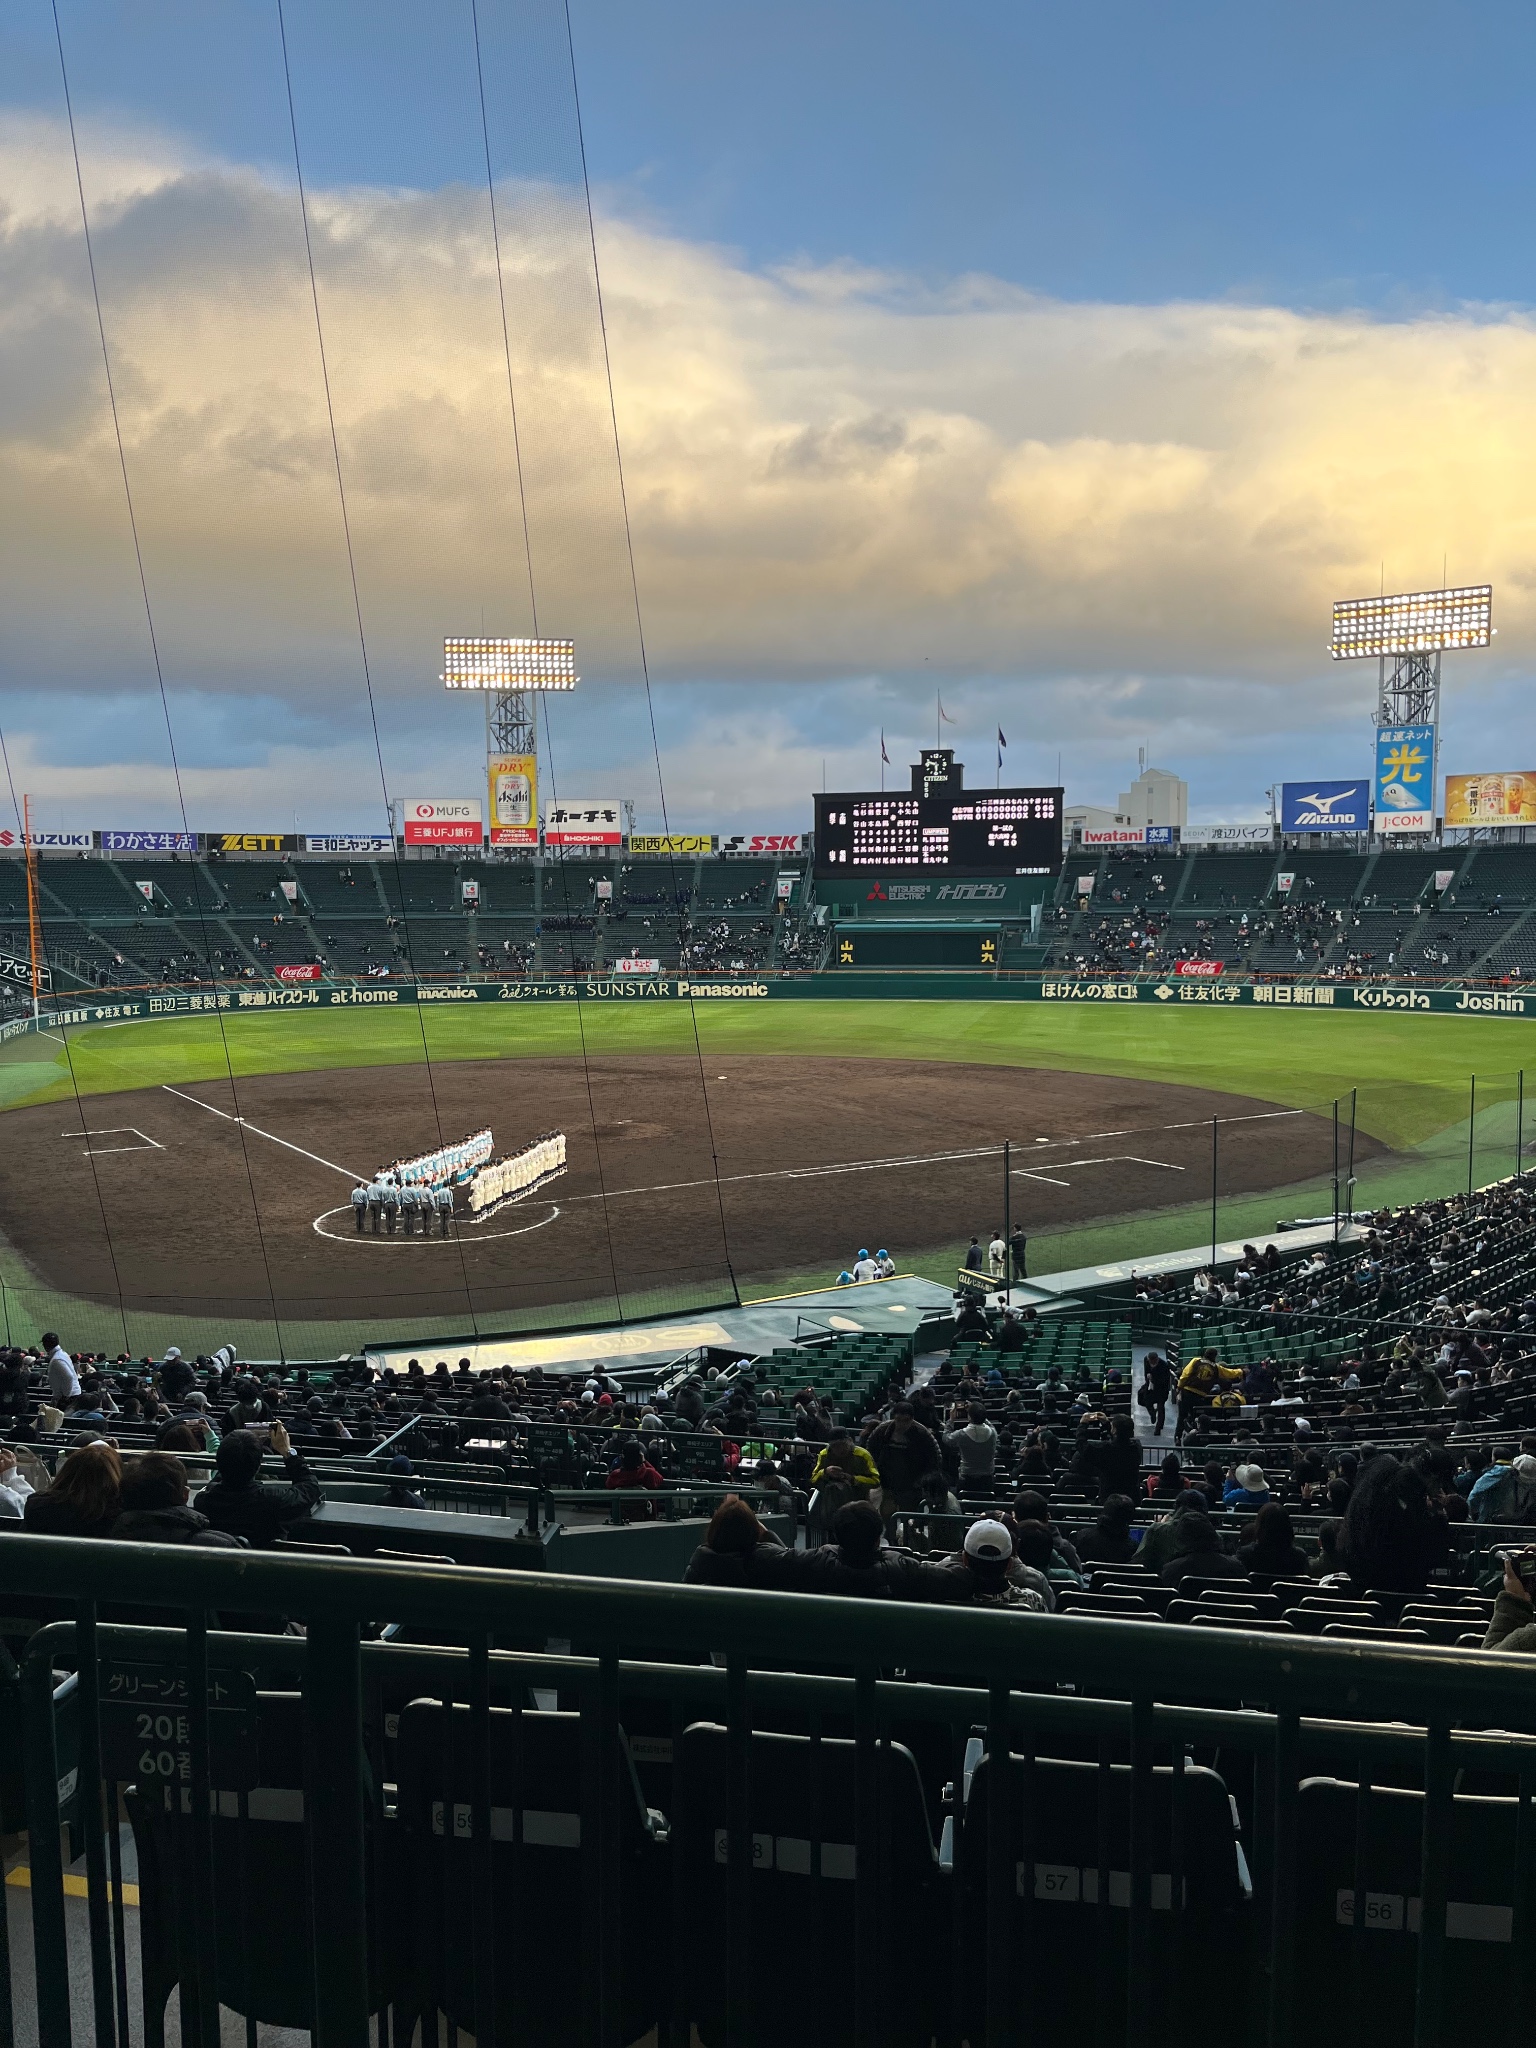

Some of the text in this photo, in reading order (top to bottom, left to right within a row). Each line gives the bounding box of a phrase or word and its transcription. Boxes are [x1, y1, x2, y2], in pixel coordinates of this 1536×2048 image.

[1379, 730, 1432, 743] 超速ネット
[1380, 744, 1430, 784] 光
[499, 790, 528, 803] Asahi
[437, 806, 469, 816] MUFG
[550, 810, 616, 823] ホーチキ
[1382, 815, 1423, 829] J:COM
[19, 834, 89, 846] SUZUKI
[414, 828, 473, 837] 三菱UFJ銀行
[1085, 829, 1143, 842] Iwatani
[1211, 826, 1271, 840] 渡辺パイプ
[107, 832, 192, 850] わかさ生活
[221, 835, 284, 851] ZETT
[311, 839, 390, 851] 三和シャッター
[631, 837, 710, 850] 関西ペイント
[749, 836, 799, 850] SSK
[889, 885, 931, 893] MITSUBISHI
[841, 940, 853, 963] 山九
[981, 939, 995, 963] 山九
[330, 987, 399, 1004] at home
[586, 982, 670, 997] SUNSTAR
[678, 981, 768, 997] Panasonic
[1041, 983, 1131, 999] ほけんの窓口
[1177, 985, 1241, 1002] 住友化学
[1253, 986, 1335, 1005] 朝日新聞
[149, 994, 231, 1013] 田辺三菱製薬
[238, 989, 319, 1007] 東進ハイスクール
[1353, 988, 1431, 1009] Kubota
[1455, 992, 1525, 1013] Joshin
[1045, 1874, 1069, 1892] 57
[1366, 1902, 1392, 1920] 56
